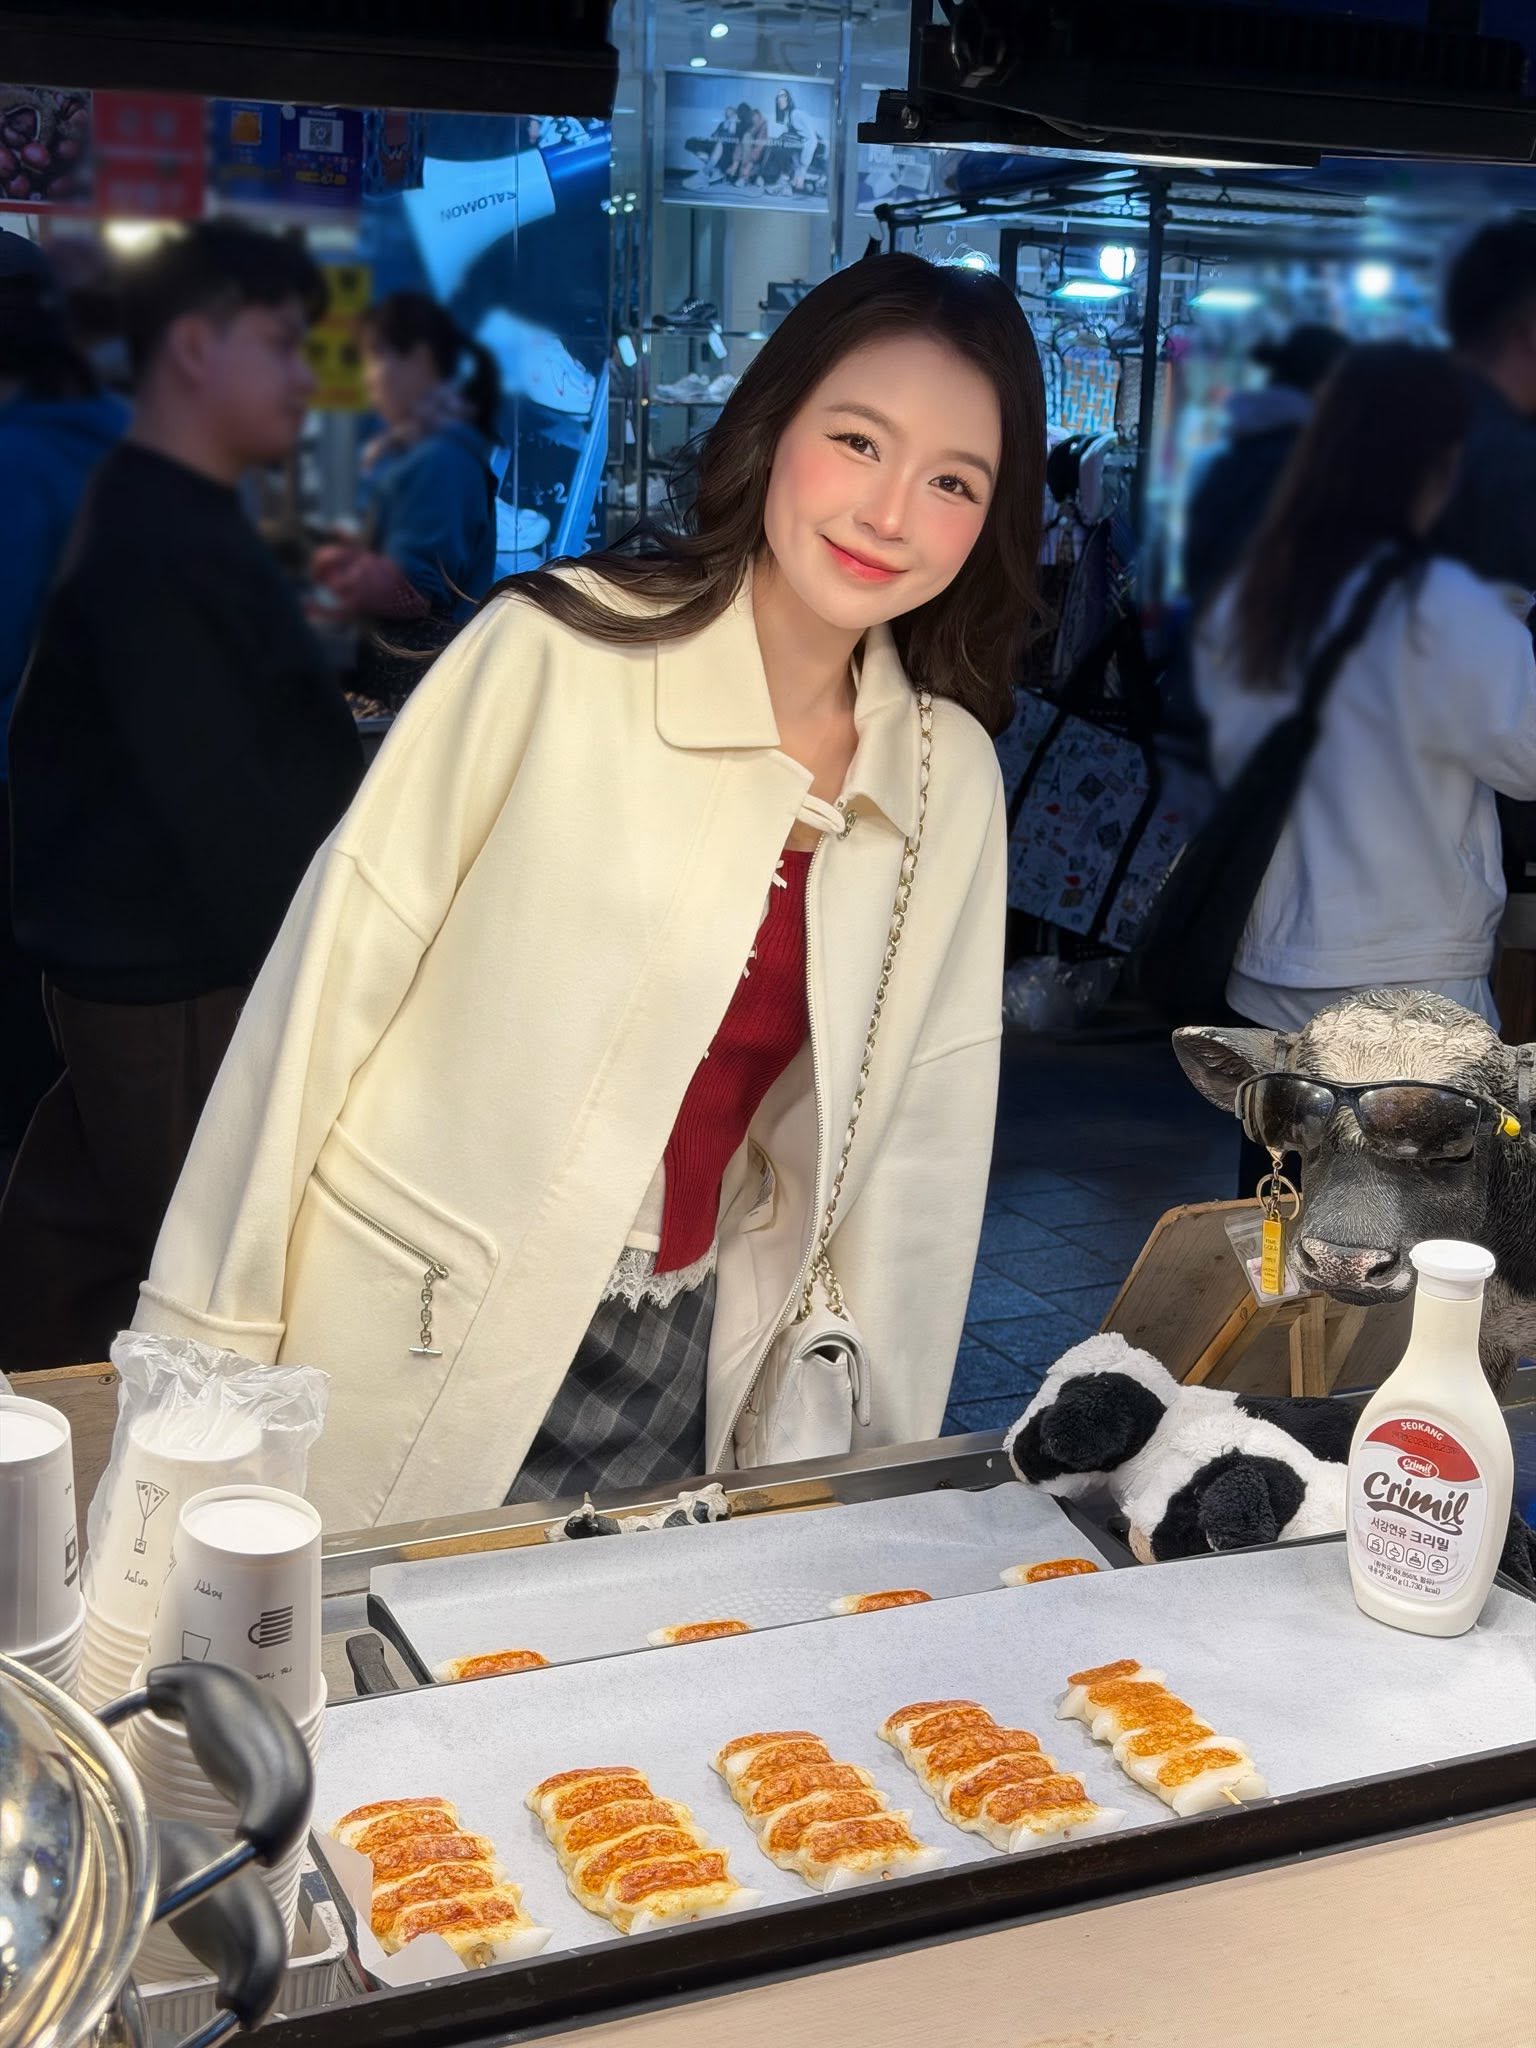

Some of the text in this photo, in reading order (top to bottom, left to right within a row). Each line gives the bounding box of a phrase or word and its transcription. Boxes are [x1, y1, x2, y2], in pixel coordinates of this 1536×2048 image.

[1400, 1421, 1445, 1441] SEOKANG
[1402, 1458, 1433, 1474] Crimil
[1363, 1471, 1470, 1528] Crimil
[1371, 1517, 1450, 1552] 서강연유 크리밀
[124, 1569, 149, 1588] enjoy
[1386, 1573, 1398, 1582] 500
[1424, 1585, 1441, 1596] kcal)
[193, 1579, 223, 1601] happy
